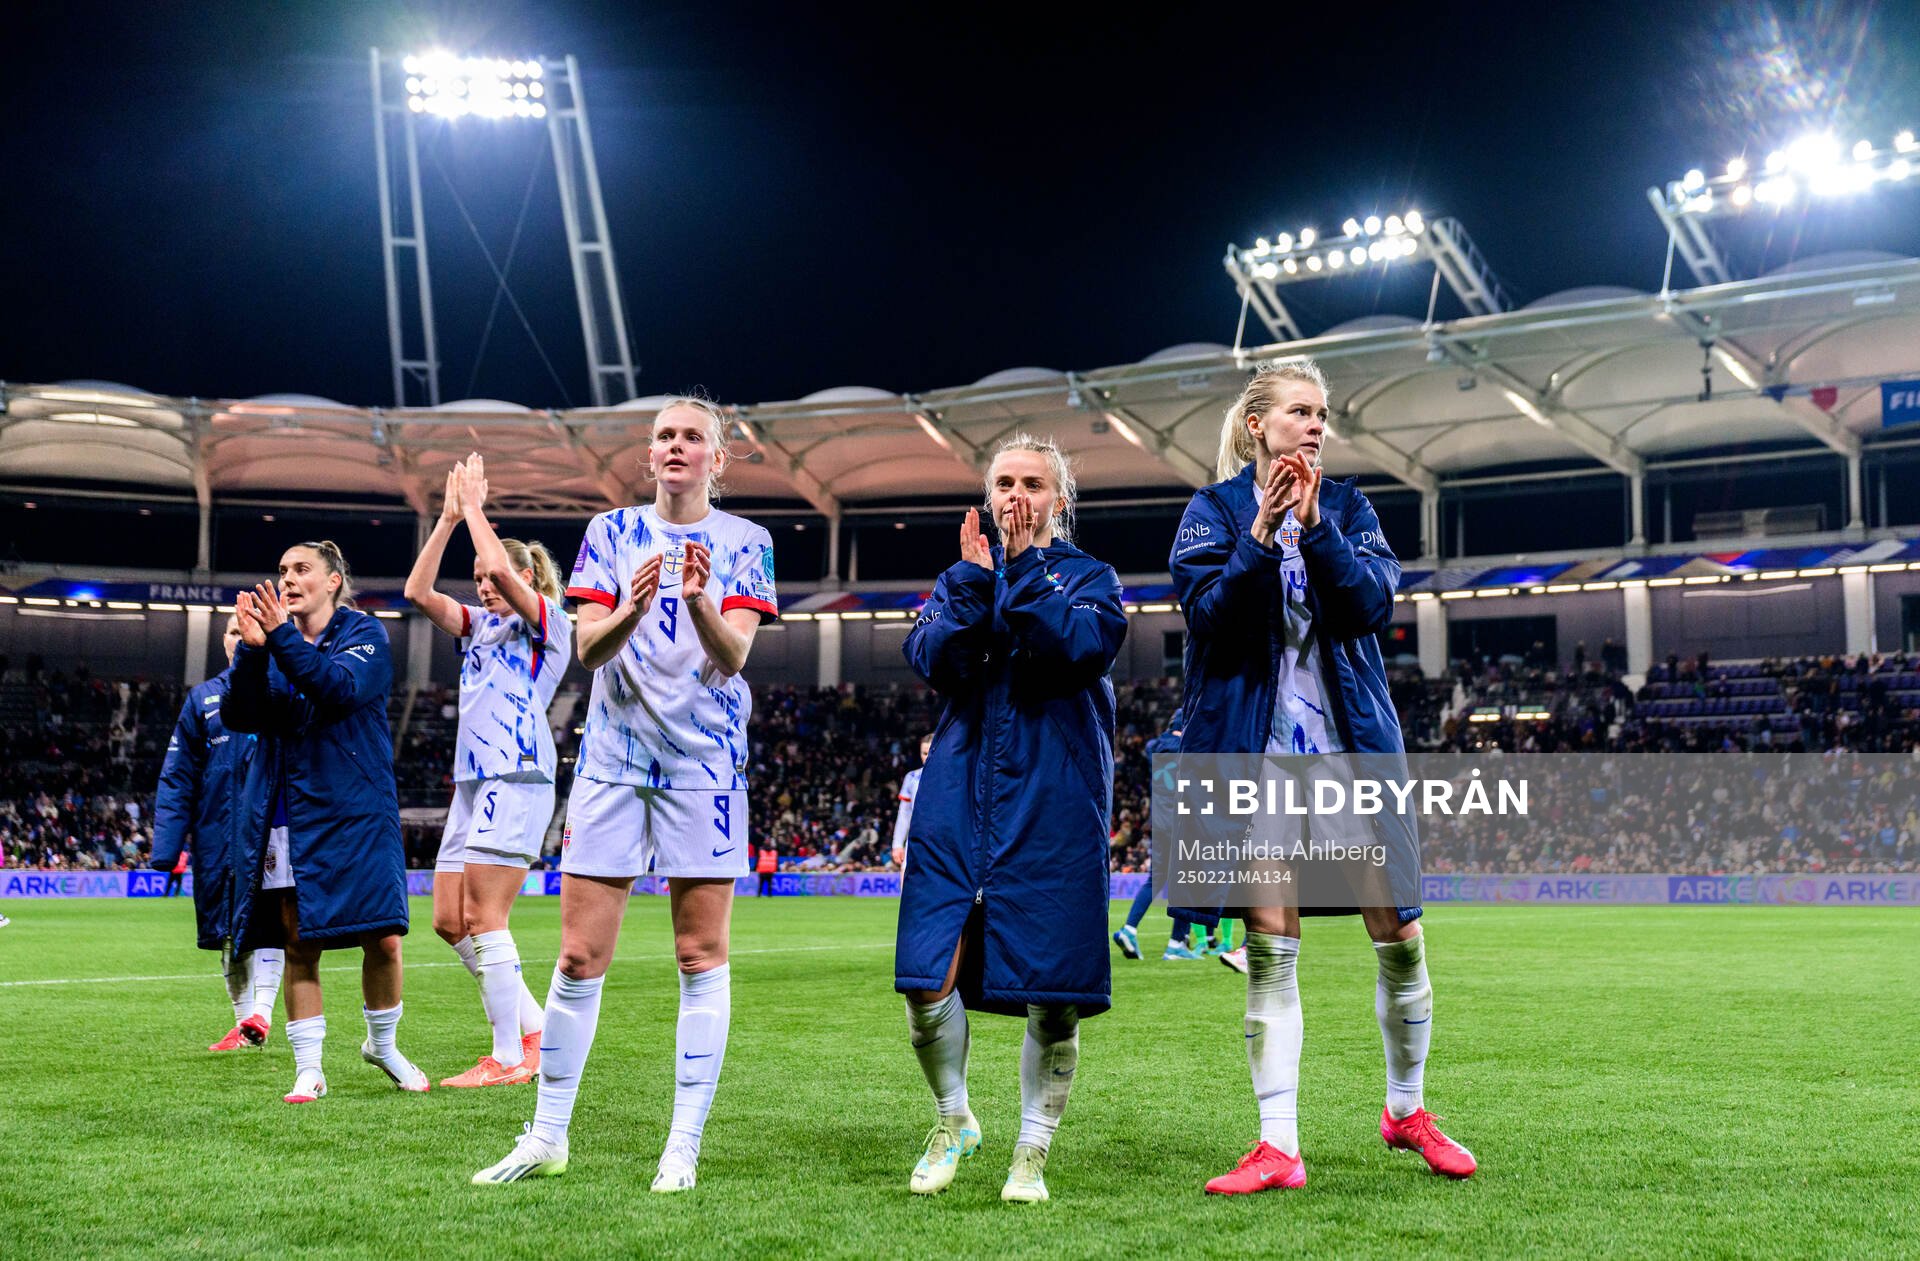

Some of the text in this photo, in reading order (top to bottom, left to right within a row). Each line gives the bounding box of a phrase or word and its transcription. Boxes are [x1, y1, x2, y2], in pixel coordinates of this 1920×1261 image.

[1181, 523, 1210, 542] DNB
[149, 584, 222, 601] FRANCE
[659, 597, 678, 644] 9
[471, 645, 481, 672] 5
[484, 791, 497, 823] 5
[714, 795, 730, 841] 9
[5, 876, 122, 894] ARKEMA
[1536, 880, 1662, 900] ARKEMA
[1675, 881, 1814, 900] ARKEMA
